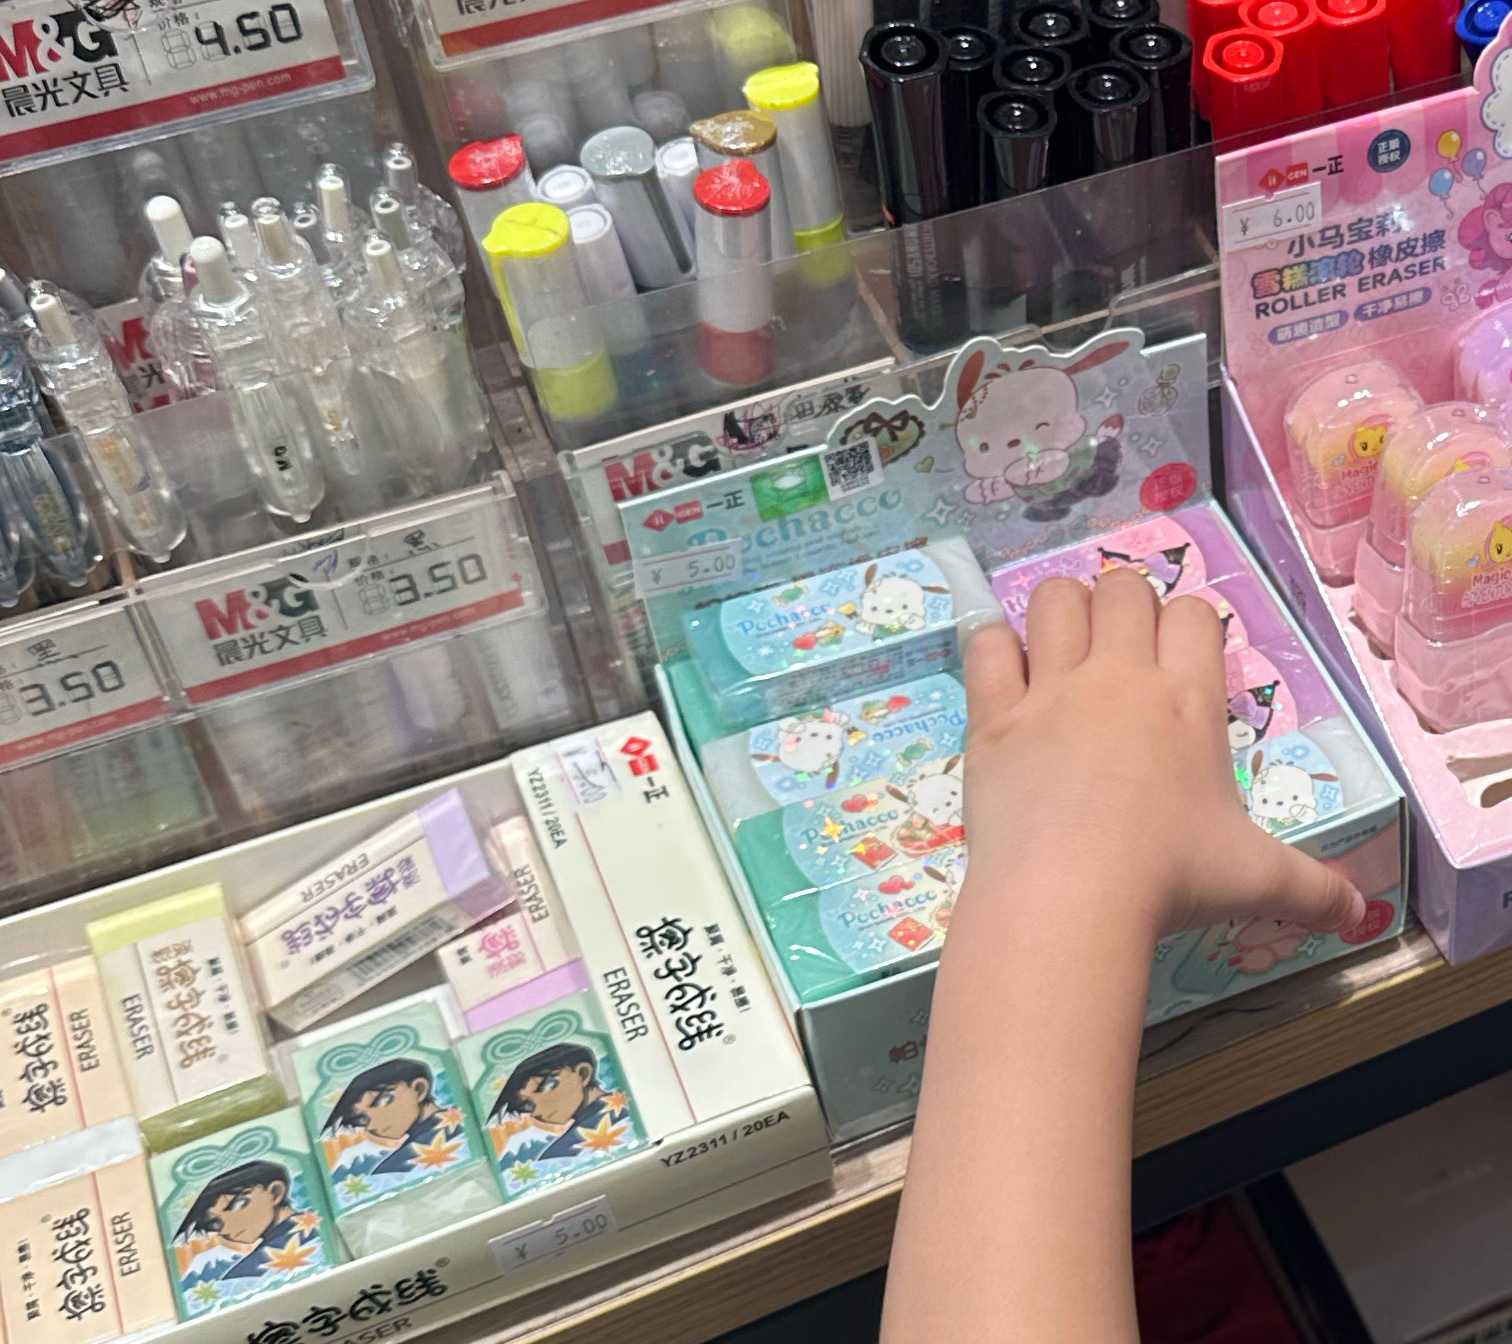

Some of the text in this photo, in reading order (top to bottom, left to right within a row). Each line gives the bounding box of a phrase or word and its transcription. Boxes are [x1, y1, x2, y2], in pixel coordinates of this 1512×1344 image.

[0, 9, 119, 82] M&G
[194, 2, 304, 58] 4.50
[1, 62, 130, 119] 晨光文具
[188, 71, 293, 106] www.mg-pen.com
[1311, 155, 1345, 177] 一正
[1272, 201, 1316, 228] 6.00
[1254, 256, 1447, 320] ROLLER ERASER
[388, 553, 488, 607] 3.50
[687, 554, 737, 579] 5.00
[195, 573, 320, 640] M&G
[212, 614, 329, 668] 晨光文具
[19, 659, 125, 717] 3.50
[800, 808, 900, 846] Phacco
[300, 852, 370, 904] ERASER
[513, 863, 551, 924] ERASER
[120, 992, 155, 1061] ERASER
[602, 966, 650, 1043] ERASER
[69, 1006, 101, 1074] ERASER
[110, 1209, 142, 1278] ERASER
[553, 1213, 610, 1247] 5.00
